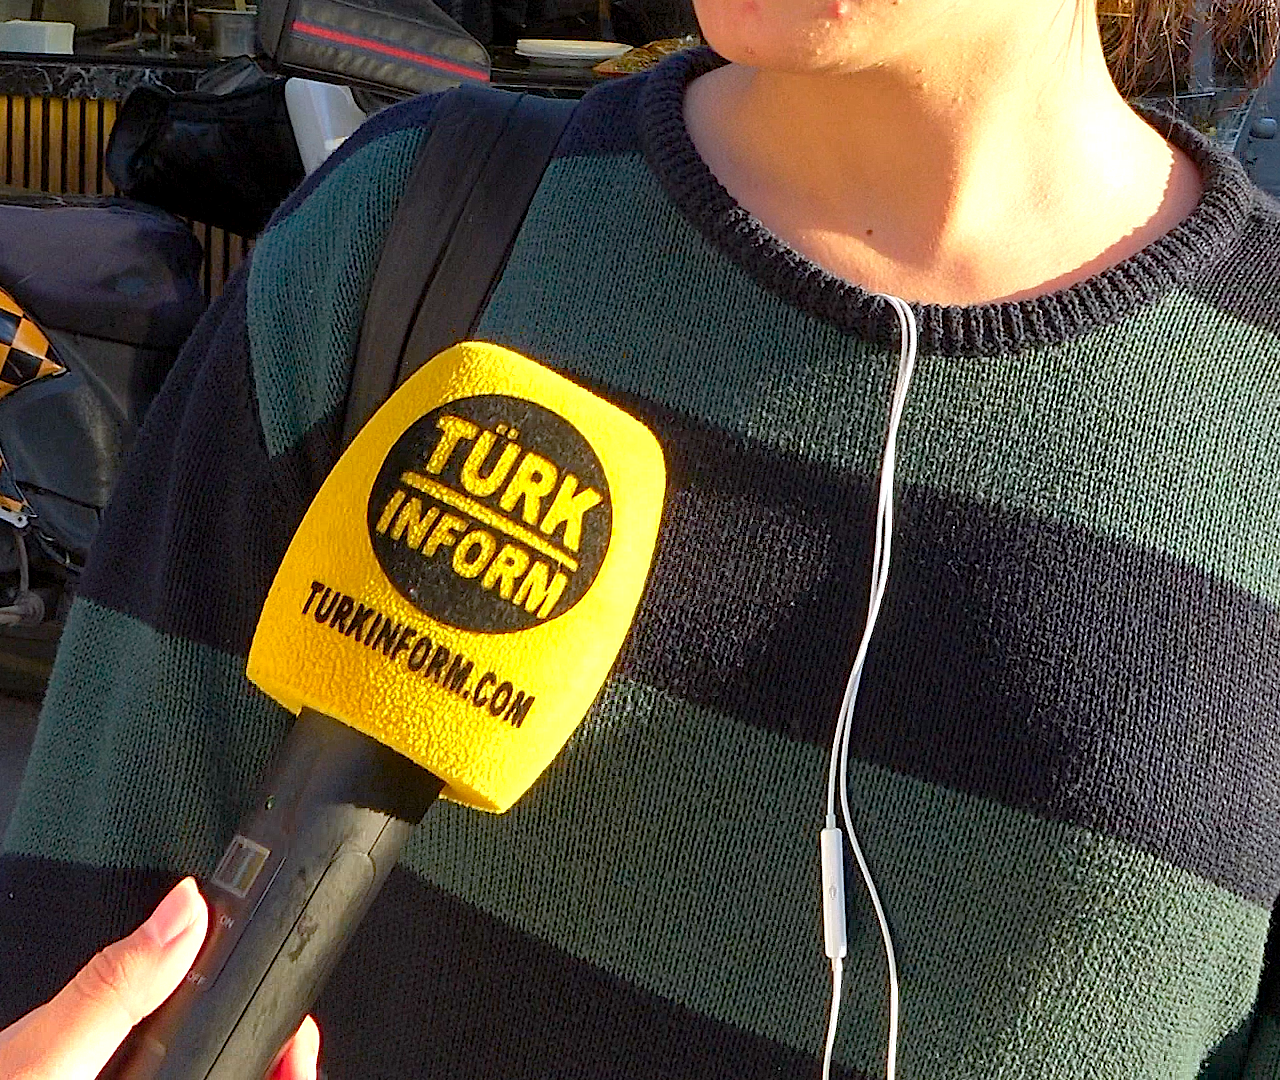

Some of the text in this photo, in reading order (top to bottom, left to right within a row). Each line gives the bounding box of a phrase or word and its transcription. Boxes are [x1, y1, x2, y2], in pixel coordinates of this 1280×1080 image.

[425, 414, 603, 554] TÜRK
[376, 489, 568, 620] INFORM
[301, 581, 536, 729] TURKINFORM.COM
[219, 913, 236, 930] ON
